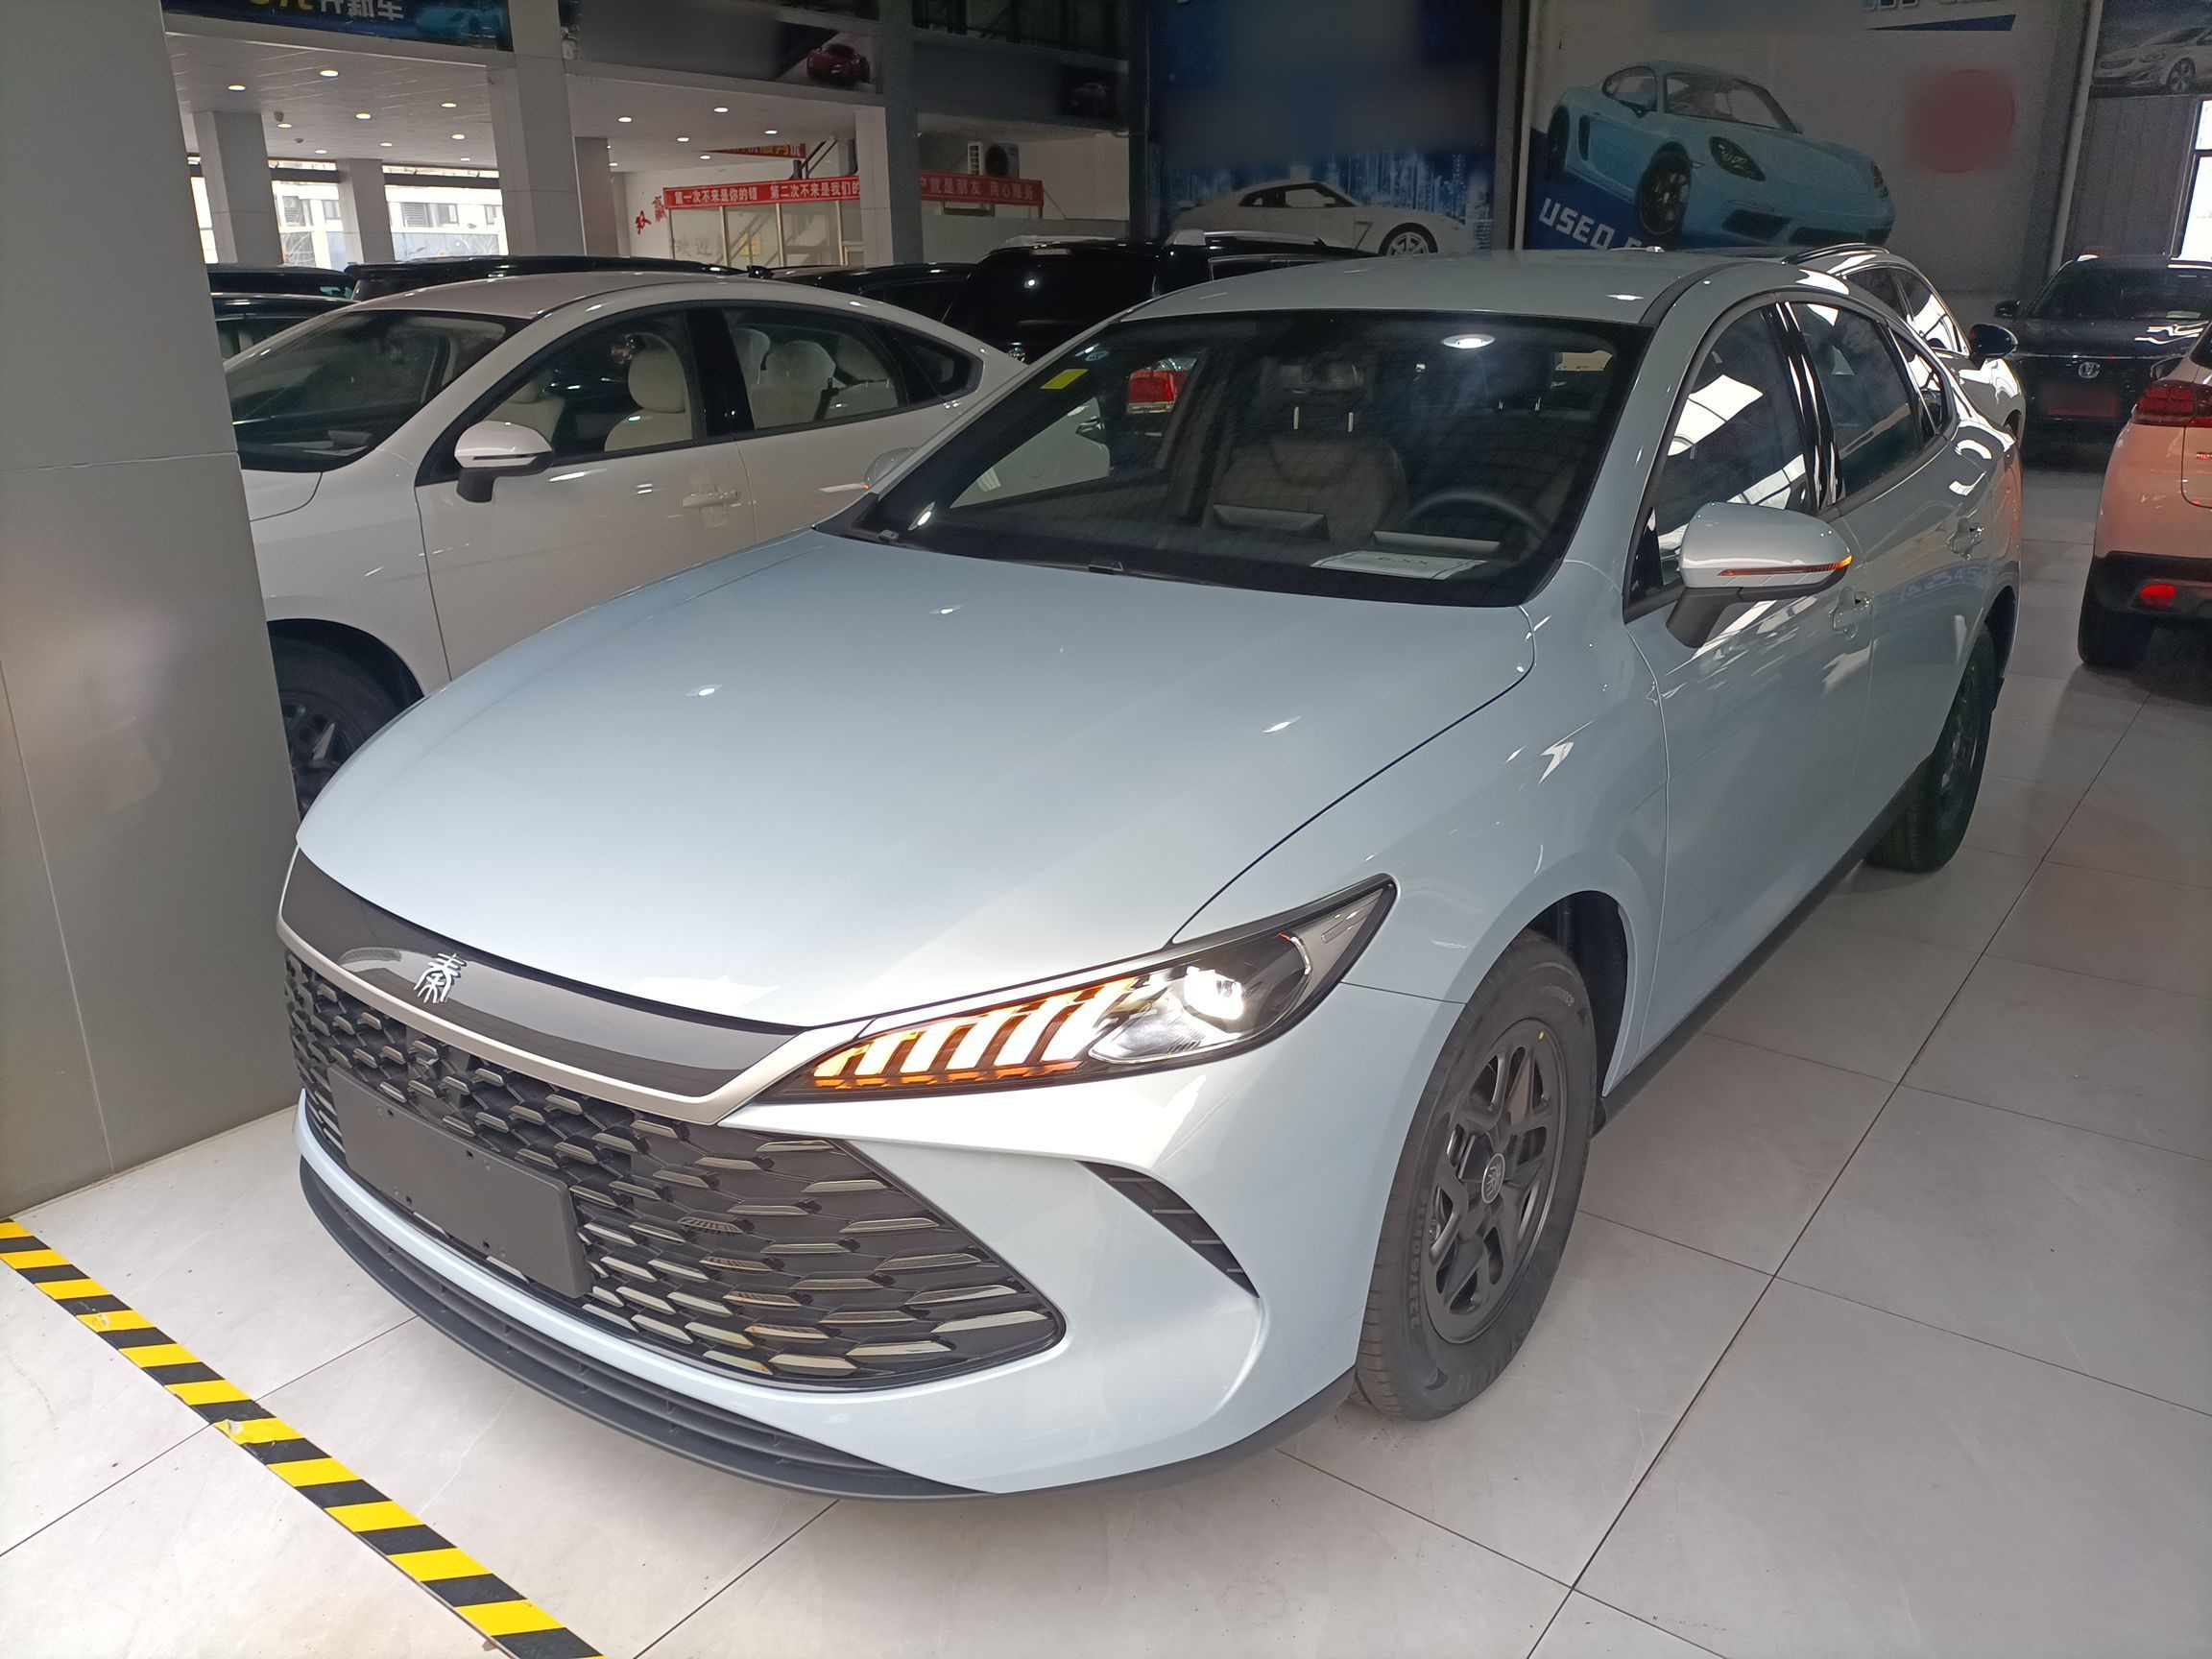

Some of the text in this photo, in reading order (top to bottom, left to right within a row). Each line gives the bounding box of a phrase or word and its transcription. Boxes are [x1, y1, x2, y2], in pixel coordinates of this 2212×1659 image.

[674, 186, 757, 205] 第一次不来是你的错
[1539, 198, 1616, 250] USED
[413, 952, 467, 1004] 秦
